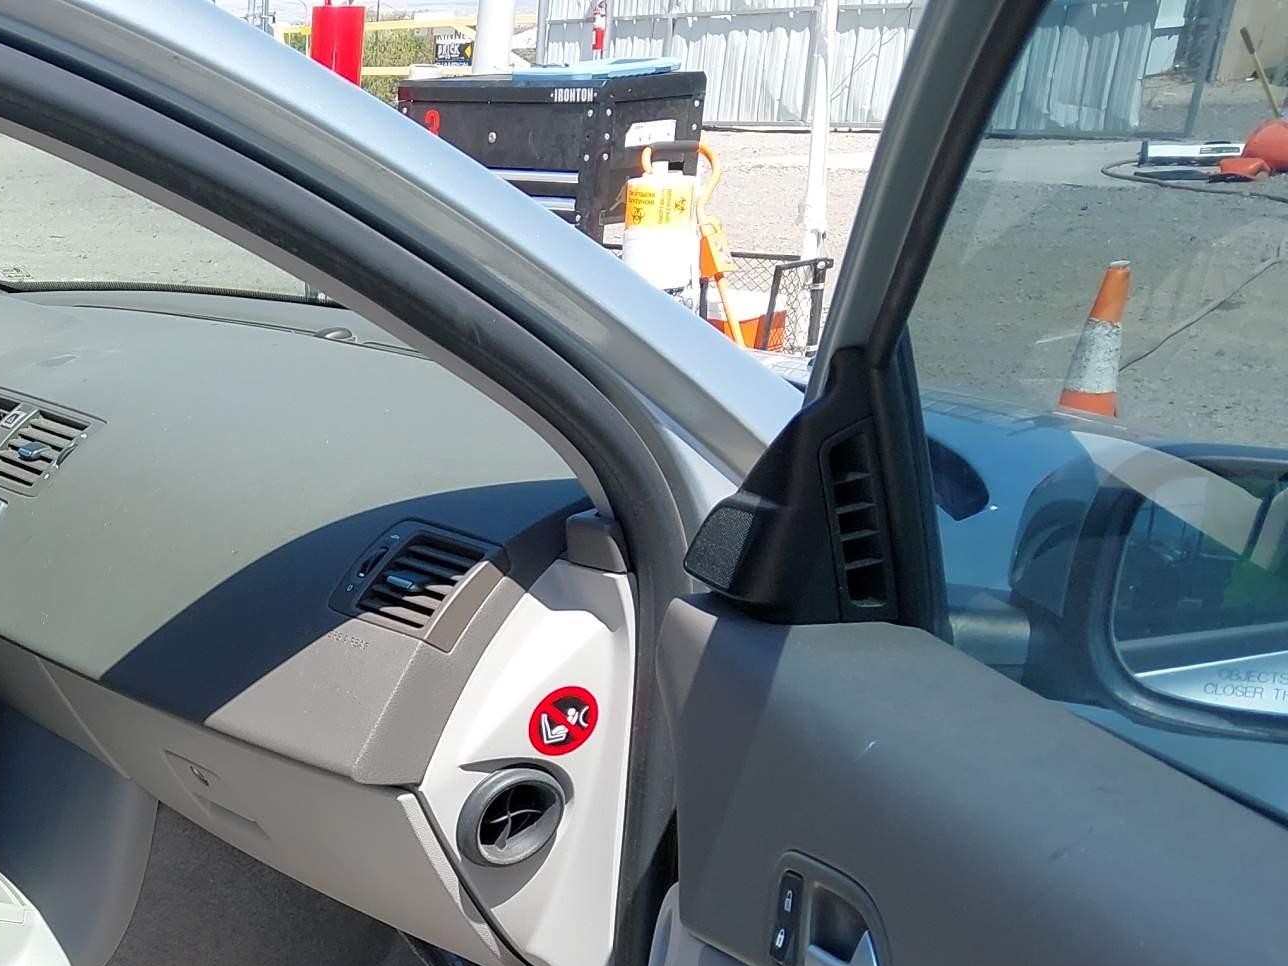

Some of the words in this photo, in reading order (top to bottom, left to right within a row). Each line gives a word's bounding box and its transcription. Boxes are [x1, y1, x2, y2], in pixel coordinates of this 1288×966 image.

[437, 44, 460, 58] BRICK
[554, 87, 593, 102] IRONTON
[1217, 667, 1288, 685] OBJECTS
[1204, 682, 1264, 700] CLOSER
